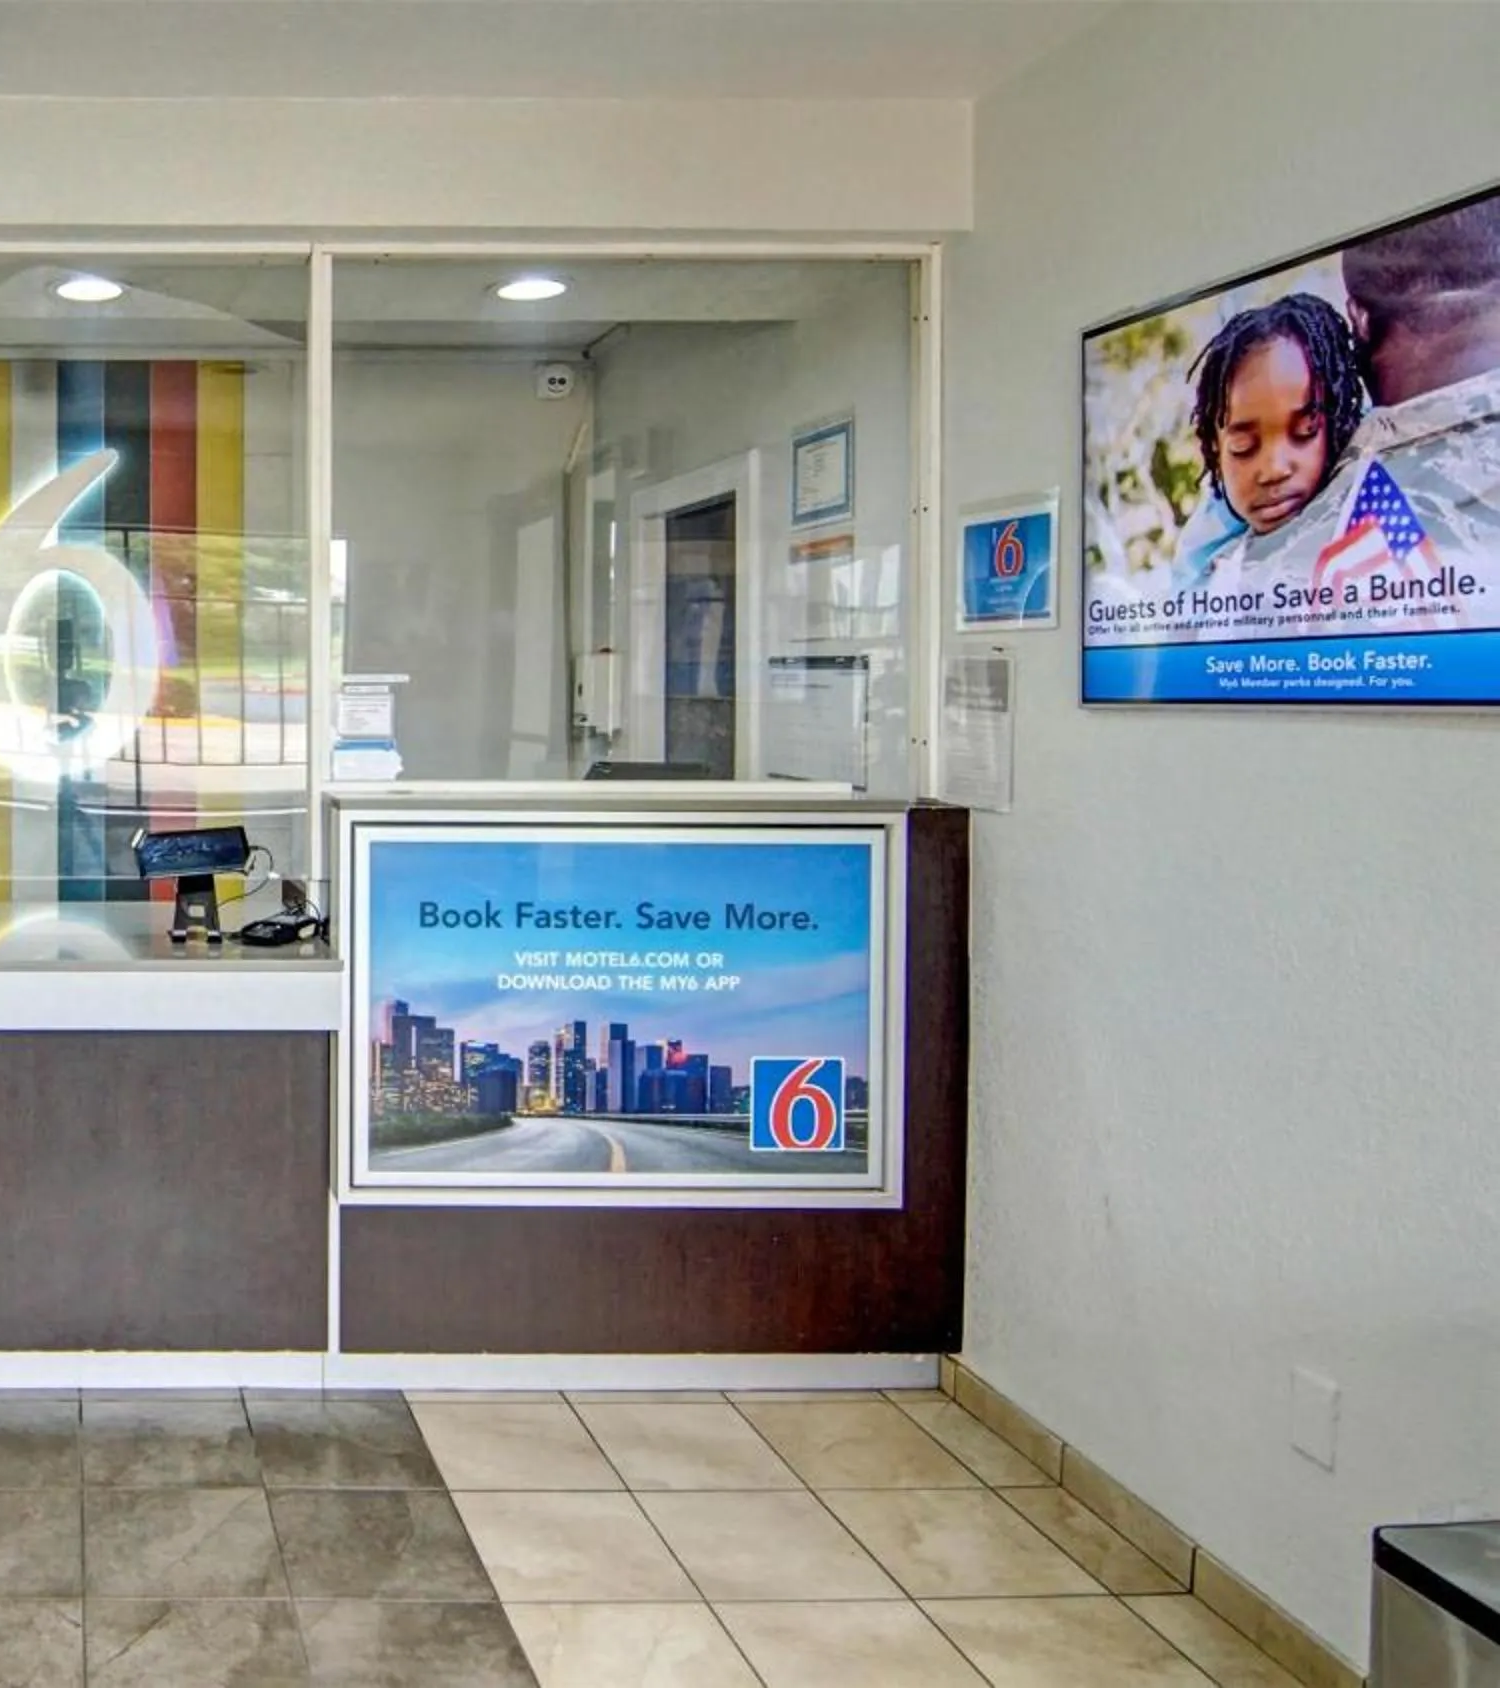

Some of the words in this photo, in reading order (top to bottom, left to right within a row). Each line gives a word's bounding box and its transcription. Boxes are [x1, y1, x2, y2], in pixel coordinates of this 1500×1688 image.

[995, 521, 1024, 577] 6
[1088, 599, 1156, 622] Guests
[1162, 591, 1186, 617] of
[1192, 590, 1265, 614] Honor
[1273, 583, 1334, 609] Save
[1343, 585, 1358, 603] a
[1370, 565, 1486, 601] Bundle.
[1088, 625, 1111, 635] Offer
[1113, 623, 1127, 633] for
[1129, 623, 1141, 633] all
[1173, 620, 1191, 630] and
[1193, 618, 1229, 629] retired
[1233, 614, 1274, 627] military
[1278, 611, 1336, 625] personnel
[1340, 608, 1363, 620] and
[1367, 605, 1398, 618] their
[1403, 603, 1461, 617] families.
[1205, 656, 1244, 673] Save
[1250, 655, 1301, 672] More.
[1307, 650, 1357, 671] Book
[1363, 650, 1433, 670] Faster.
[1241, 676, 1281, 688] Member
[1283, 676, 1311, 690] perks
[1313, 675, 1366, 689] designed.
[1368, 675, 1388, 687] For
[1390, 677, 1416, 689] you.
[419, 900, 502, 929] Book
[515, 902, 623, 930] Faster.
[636, 902, 711, 930] Save
[724, 903, 820, 931] More.
[514, 952, 558, 968] VISIT
[565, 952, 690, 968] MOTEL6.COM
[696, 952, 725, 968] OR
[497, 974, 612, 991] DOWNLOAD
[618, 974, 654, 991] THE
[660, 974, 699, 991] MY6
[705, 974, 741, 991] APP
[770, 1057, 837, 1150] 6
